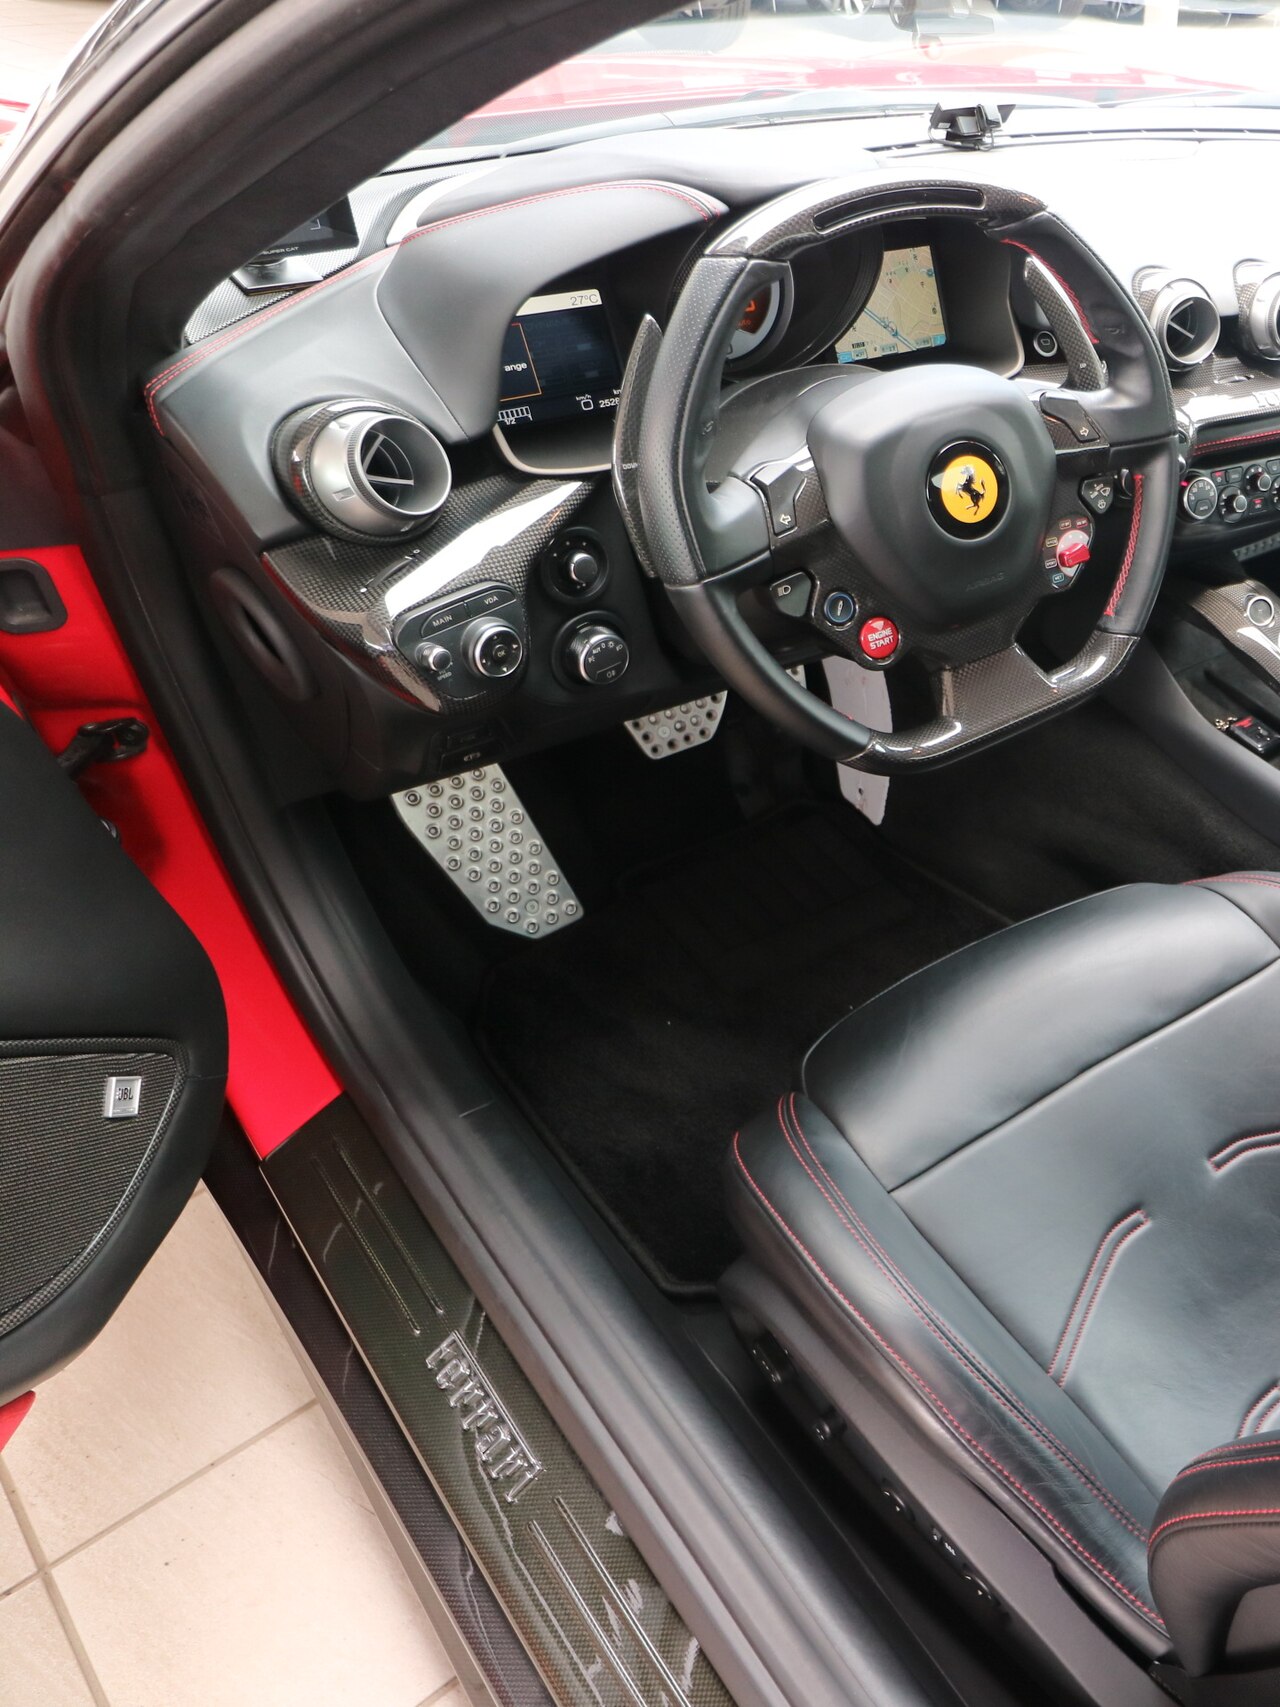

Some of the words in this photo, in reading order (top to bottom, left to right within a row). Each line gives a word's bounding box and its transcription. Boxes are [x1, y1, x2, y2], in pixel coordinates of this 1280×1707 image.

[504, 361, 528, 372] ange
[575, 393, 592, 401] km/h
[483, 595, 499, 606] VDA
[432, 614, 453, 628] MAIN
[867, 627, 893, 642] ENGINE
[869, 635, 894, 650] START
[118, 1087, 134, 1101] JBL
[425, 1329, 547, 1504] Ferrari
